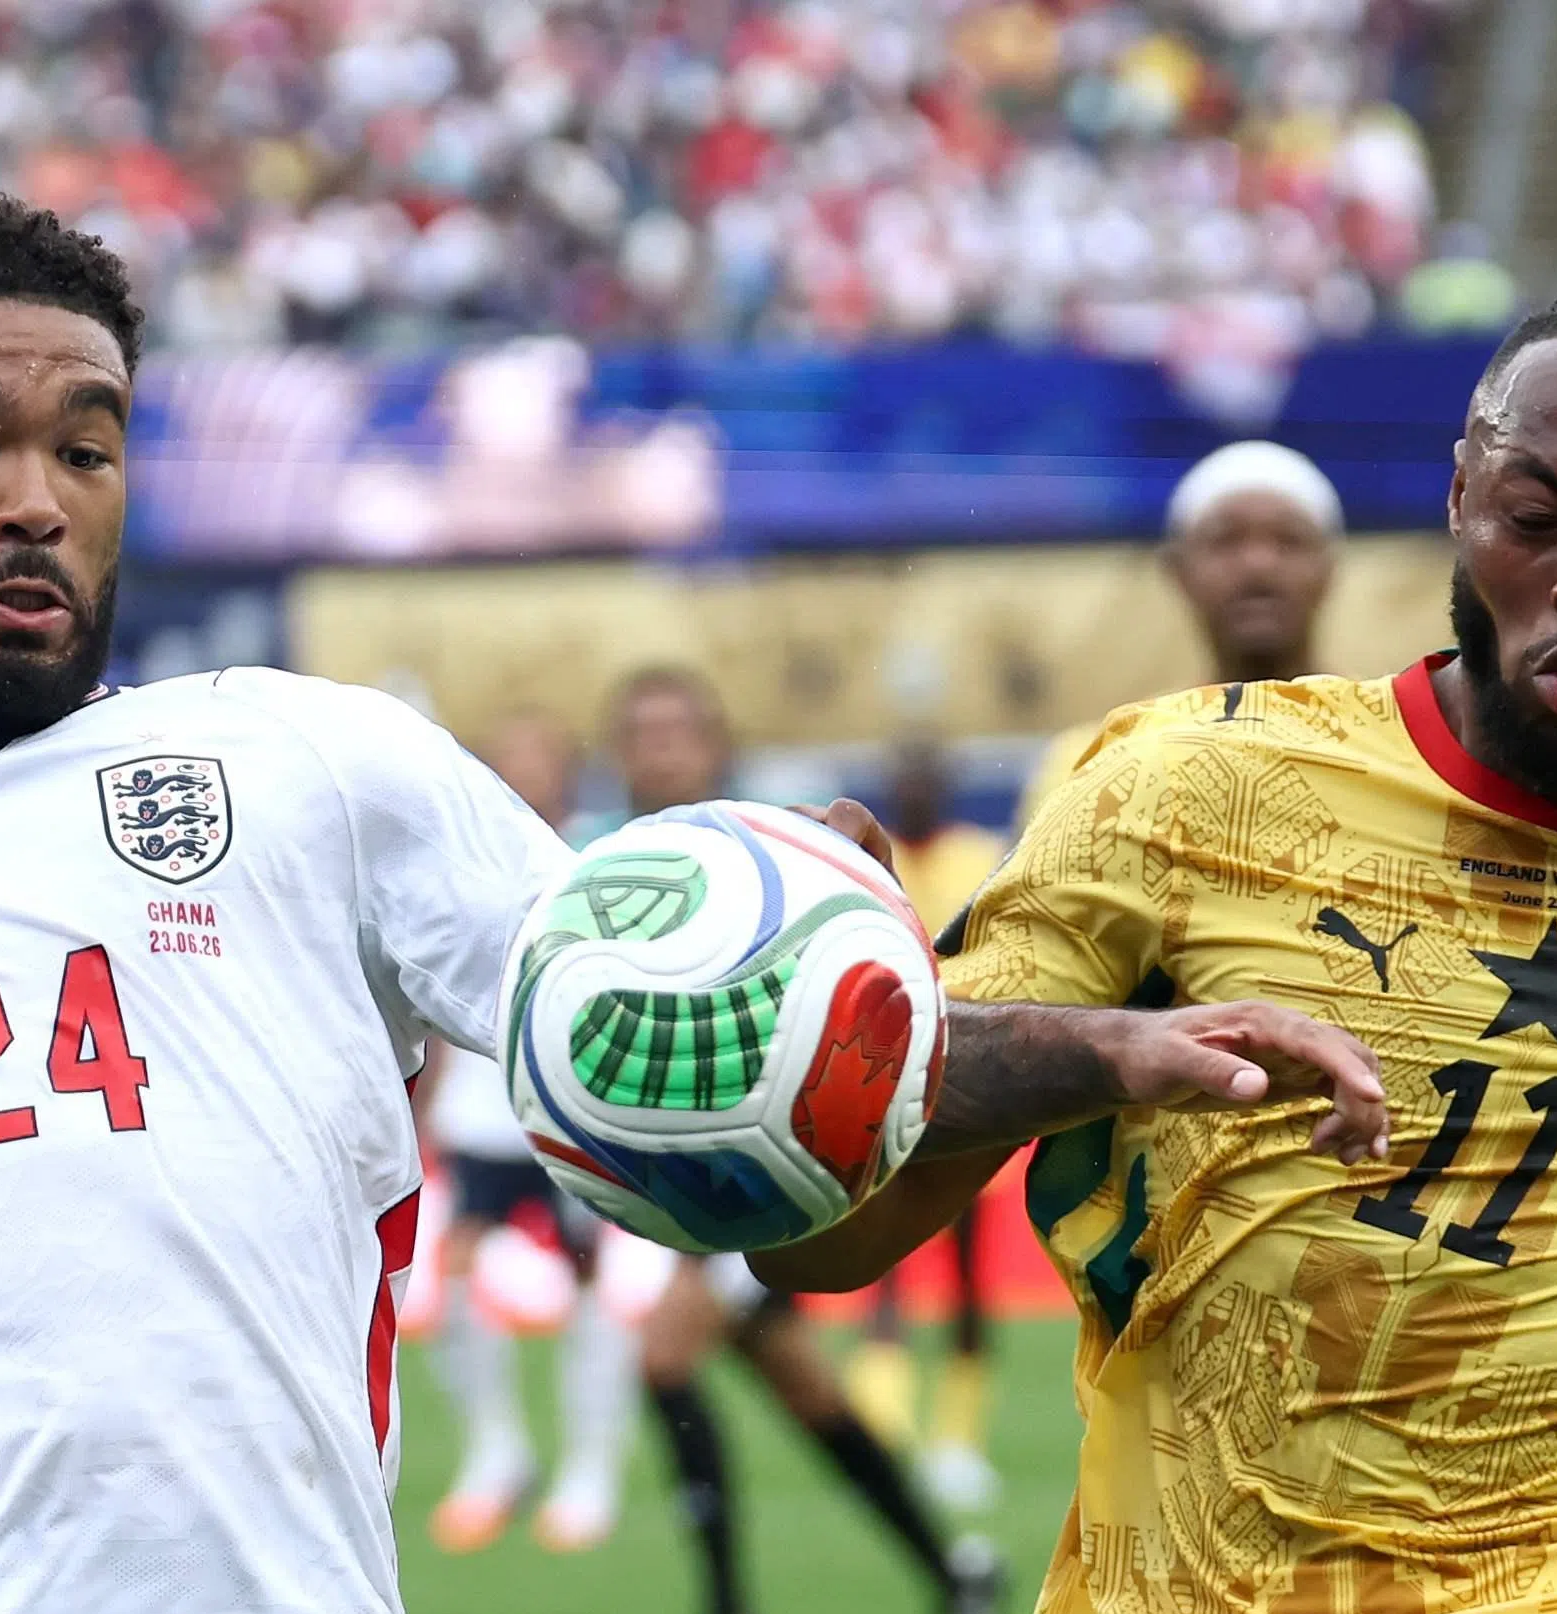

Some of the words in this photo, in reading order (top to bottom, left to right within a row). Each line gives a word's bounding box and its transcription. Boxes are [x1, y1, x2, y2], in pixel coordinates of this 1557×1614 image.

[1459, 857, 1547, 883] ENGLAND
[1502, 890, 1543, 907] June
[147, 901, 216, 927] GHANA
[149, 930, 221, 957] 23.06.26
